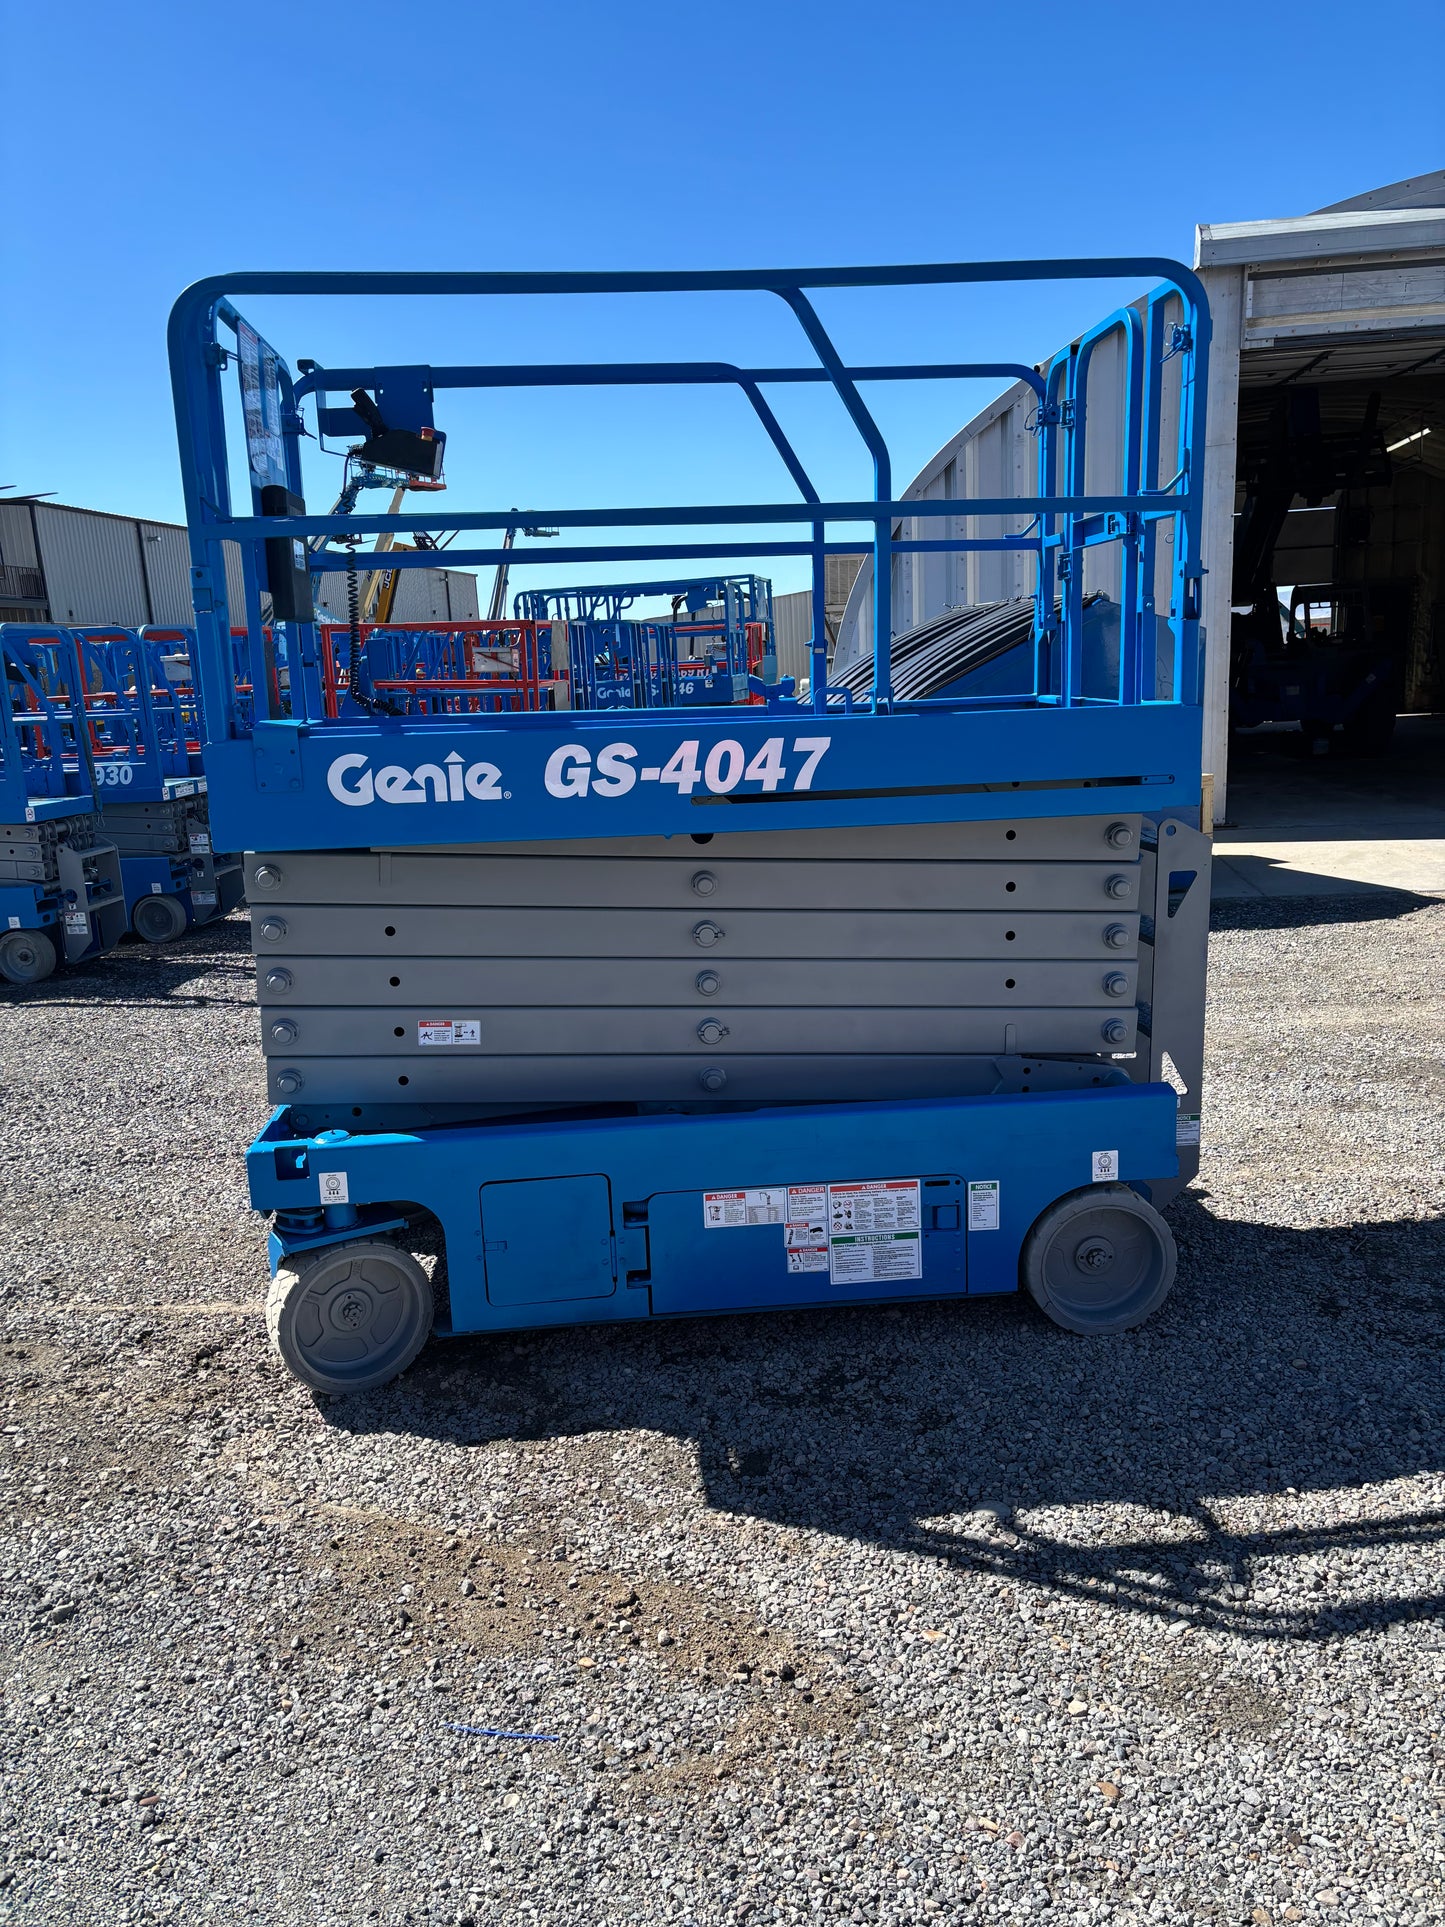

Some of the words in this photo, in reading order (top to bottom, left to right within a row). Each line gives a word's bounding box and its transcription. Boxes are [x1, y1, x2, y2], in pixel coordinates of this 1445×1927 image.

[327, 751, 503, 806] Genie
[544, 737, 831, 798] GS-4047
[854, 1233, 896, 1242] INSTRUCTIONS
